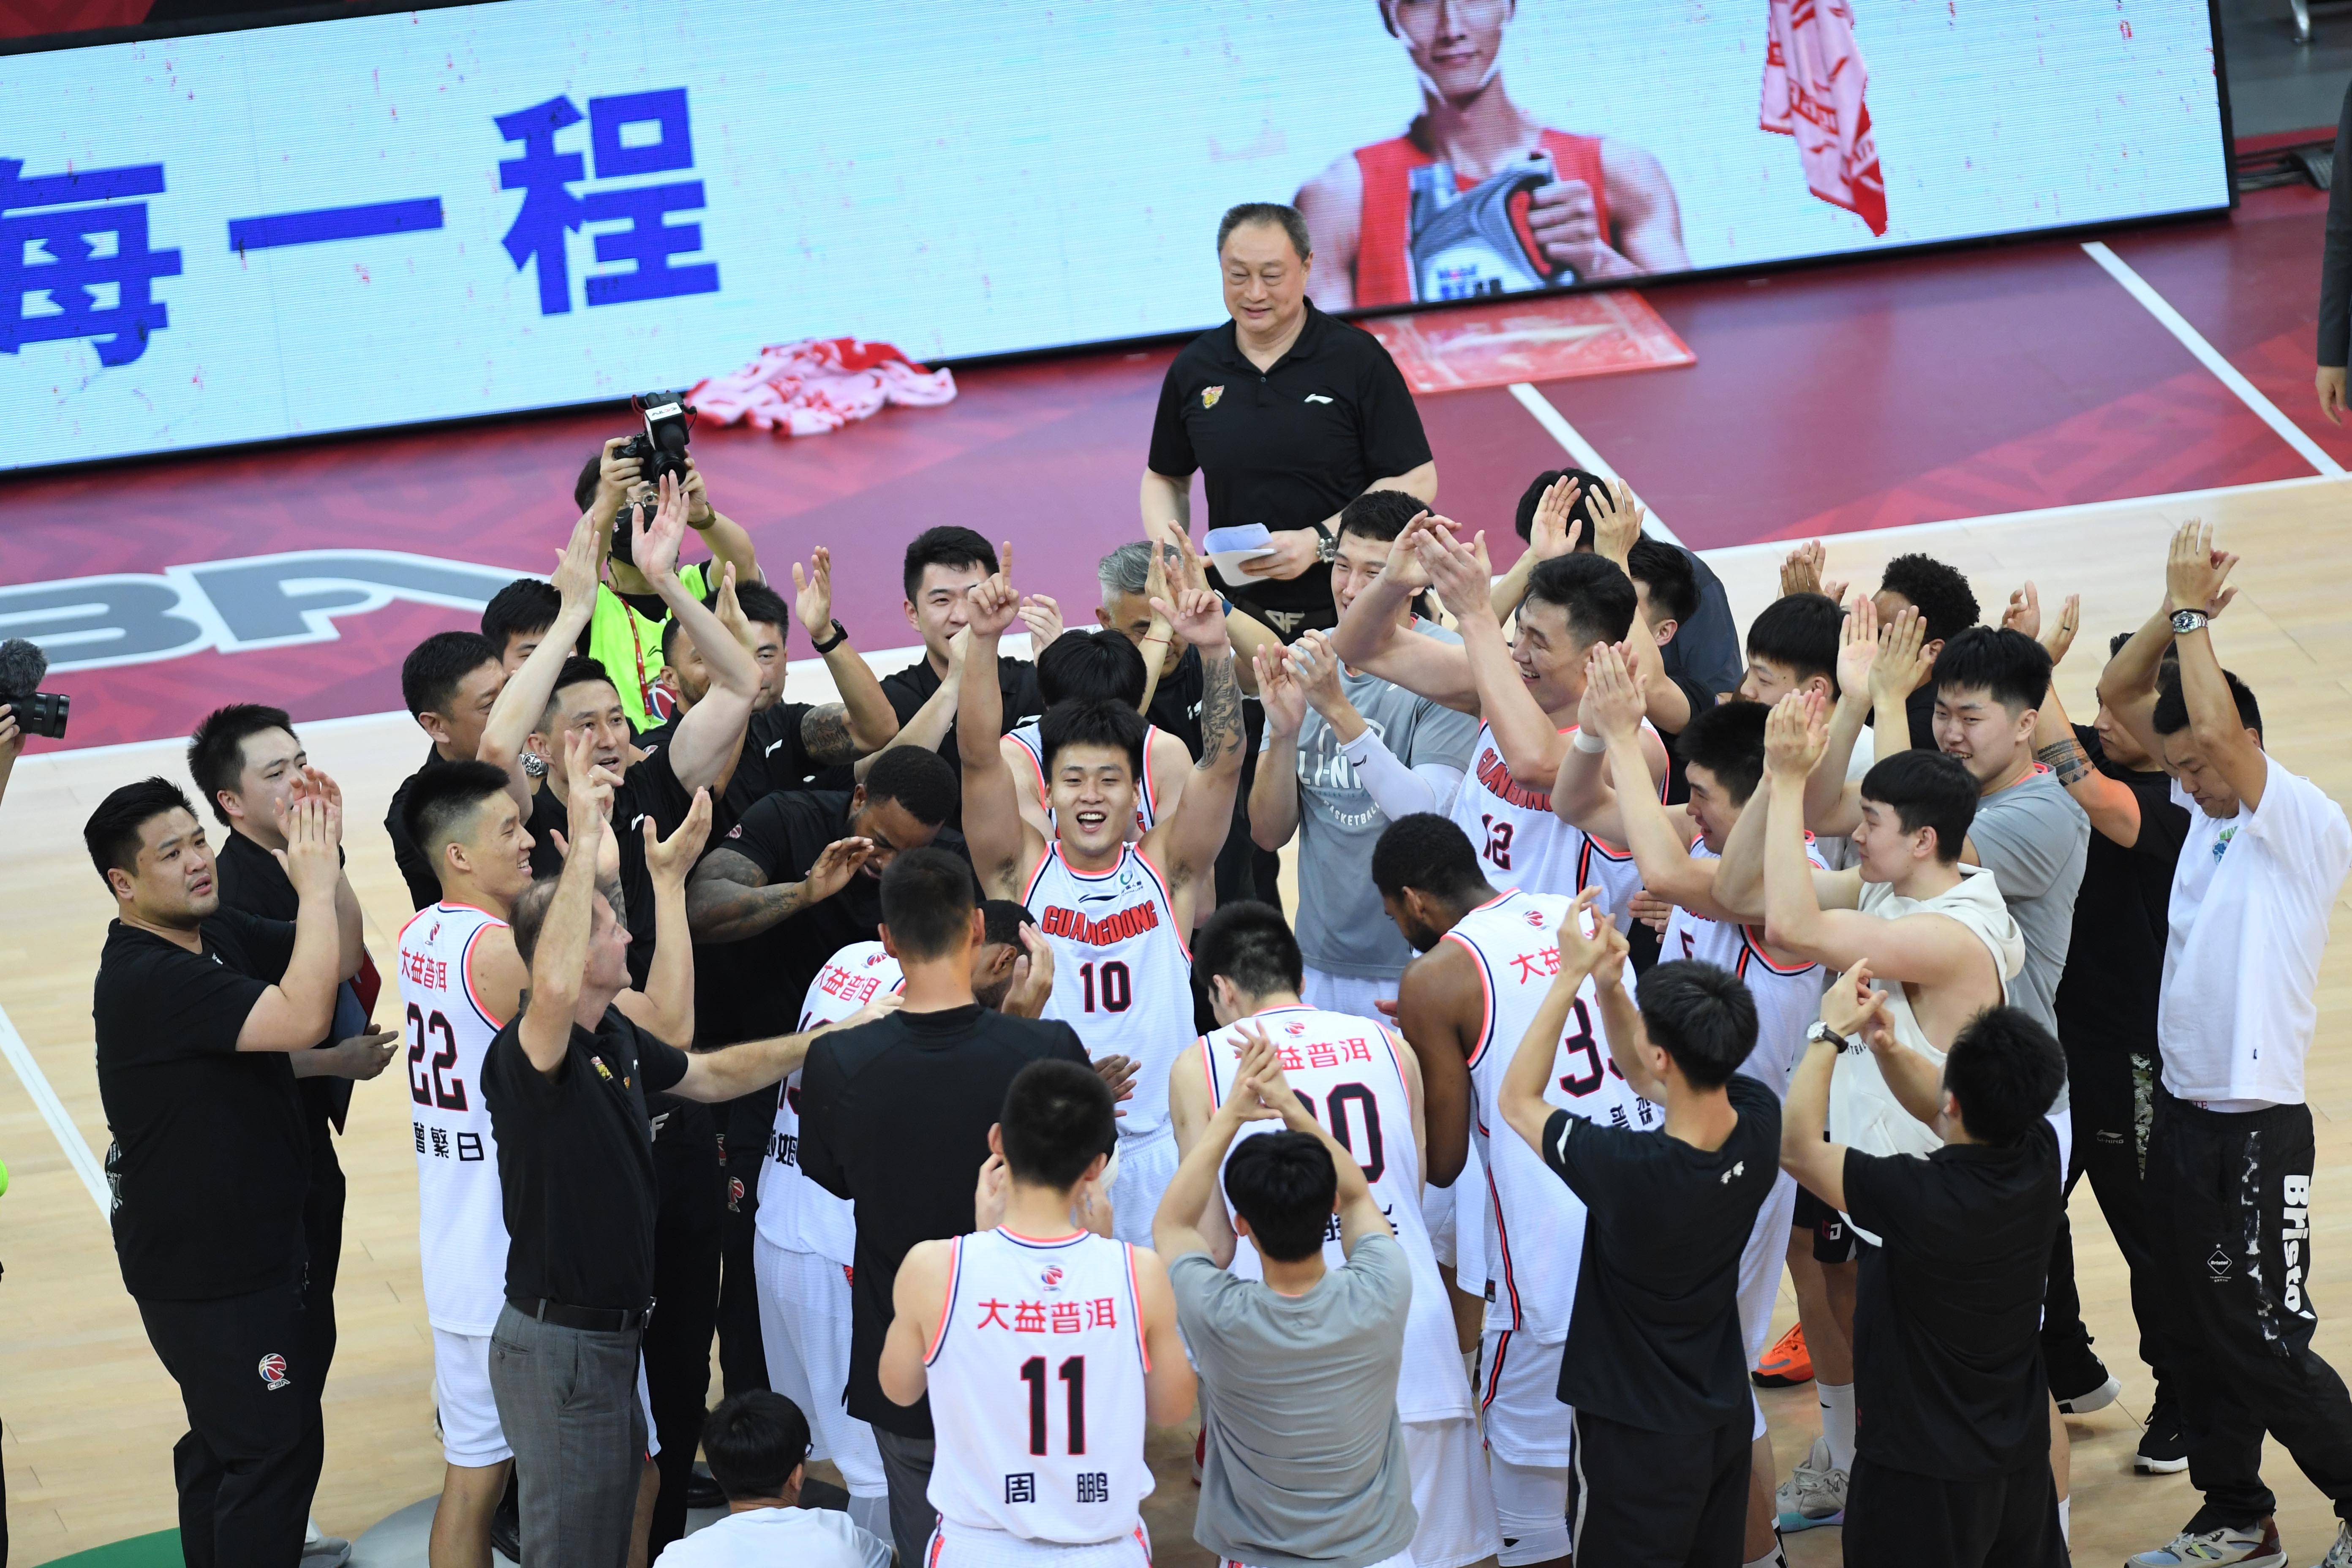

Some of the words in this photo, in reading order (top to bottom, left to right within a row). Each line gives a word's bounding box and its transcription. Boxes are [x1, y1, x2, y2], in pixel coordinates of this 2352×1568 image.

[1481, 813, 1514, 871] 12
[1042, 899, 1159, 947] GUANGDONG
[400, 945, 447, 993] 大益普洱
[813, 961, 882, 1006] 大益普洱
[1080, 960, 1132, 1013] 10
[407, 1001, 469, 1112] 22
[1235, 1037, 1372, 1070] 益普洱
[413, 1122, 485, 1162] 曾繁日
[977, 1296, 1117, 1334] 大益普洱
[268, 1379, 290, 1390] CBA
[1020, 1354, 1086, 1456] 11
[1004, 1472, 1109, 1504] 周鹏
